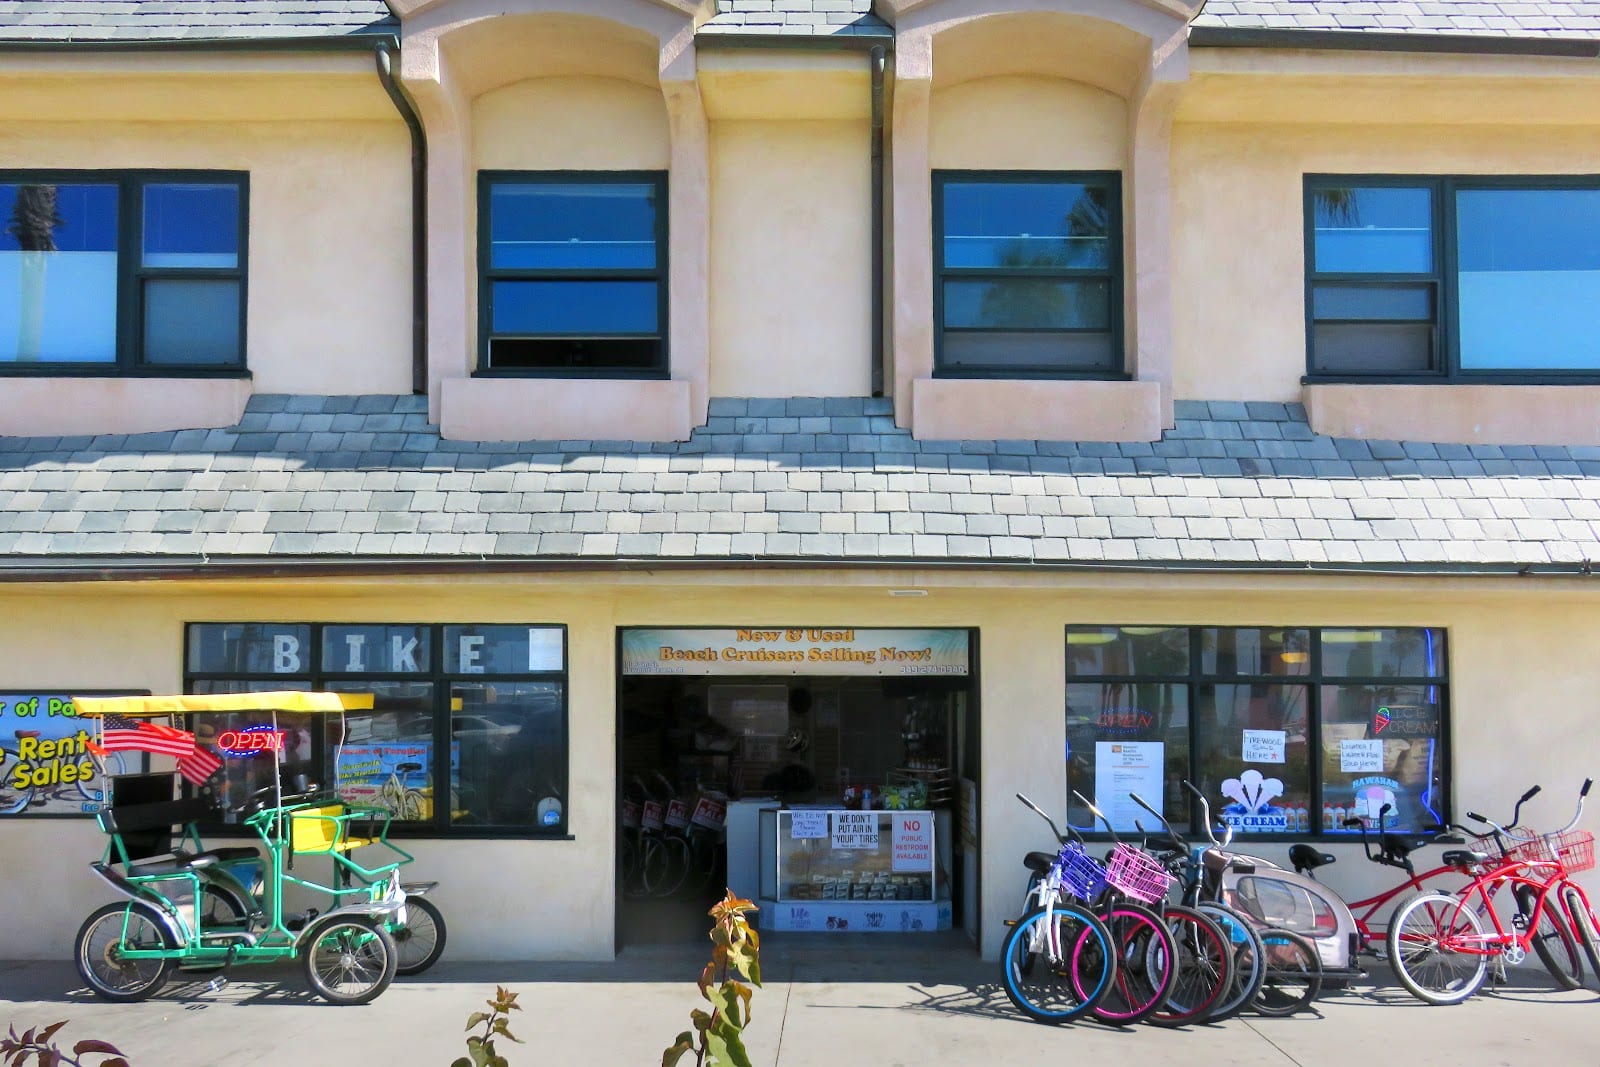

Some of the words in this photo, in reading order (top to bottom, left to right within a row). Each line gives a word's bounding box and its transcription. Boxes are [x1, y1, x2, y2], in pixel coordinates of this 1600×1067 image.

[737, 628, 781, 642] New
[785, 628, 802, 642] &
[807, 628, 855, 642] Used
[660, 646, 718, 661] Beach
[721, 646, 804, 662] Cruisers
[808, 646, 876, 665] Selling
[880, 646, 932, 662] Now!
[15, 697, 38, 716] of
[20, 731, 103, 761] Rent
[217, 731, 284, 749] OPEN
[14, 759, 93, 788] Sales
[839, 815, 850, 823] WE
[852, 815, 871, 823] DON'T
[904, 820, 920, 831] NO
[1244, 816, 1285, 826] CREAM
[839, 825, 851, 833] PUT
[853, 825, 864, 833] AIR
[866, 825, 872, 833] IN
[860, 835, 878, 843] TIRES
